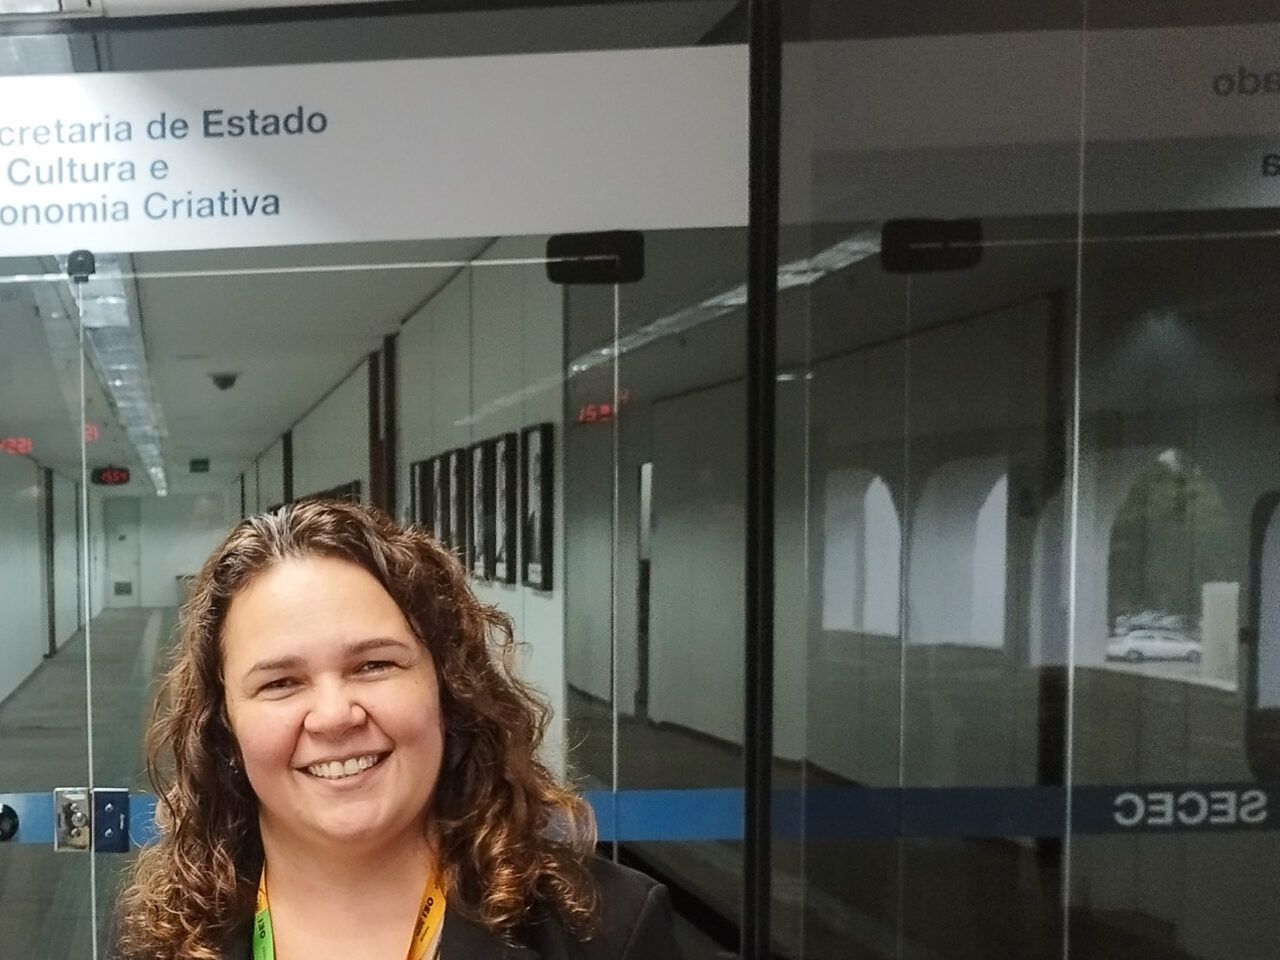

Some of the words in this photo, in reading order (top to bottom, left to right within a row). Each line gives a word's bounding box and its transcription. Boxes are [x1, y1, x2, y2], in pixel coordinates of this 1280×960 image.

[146, 112, 190, 142] de
[202, 106, 329, 138] Estado
[7, 151, 137, 186] Cultura
[149, 157, 169, 181] e
[143, 186, 282, 221] Criativa
